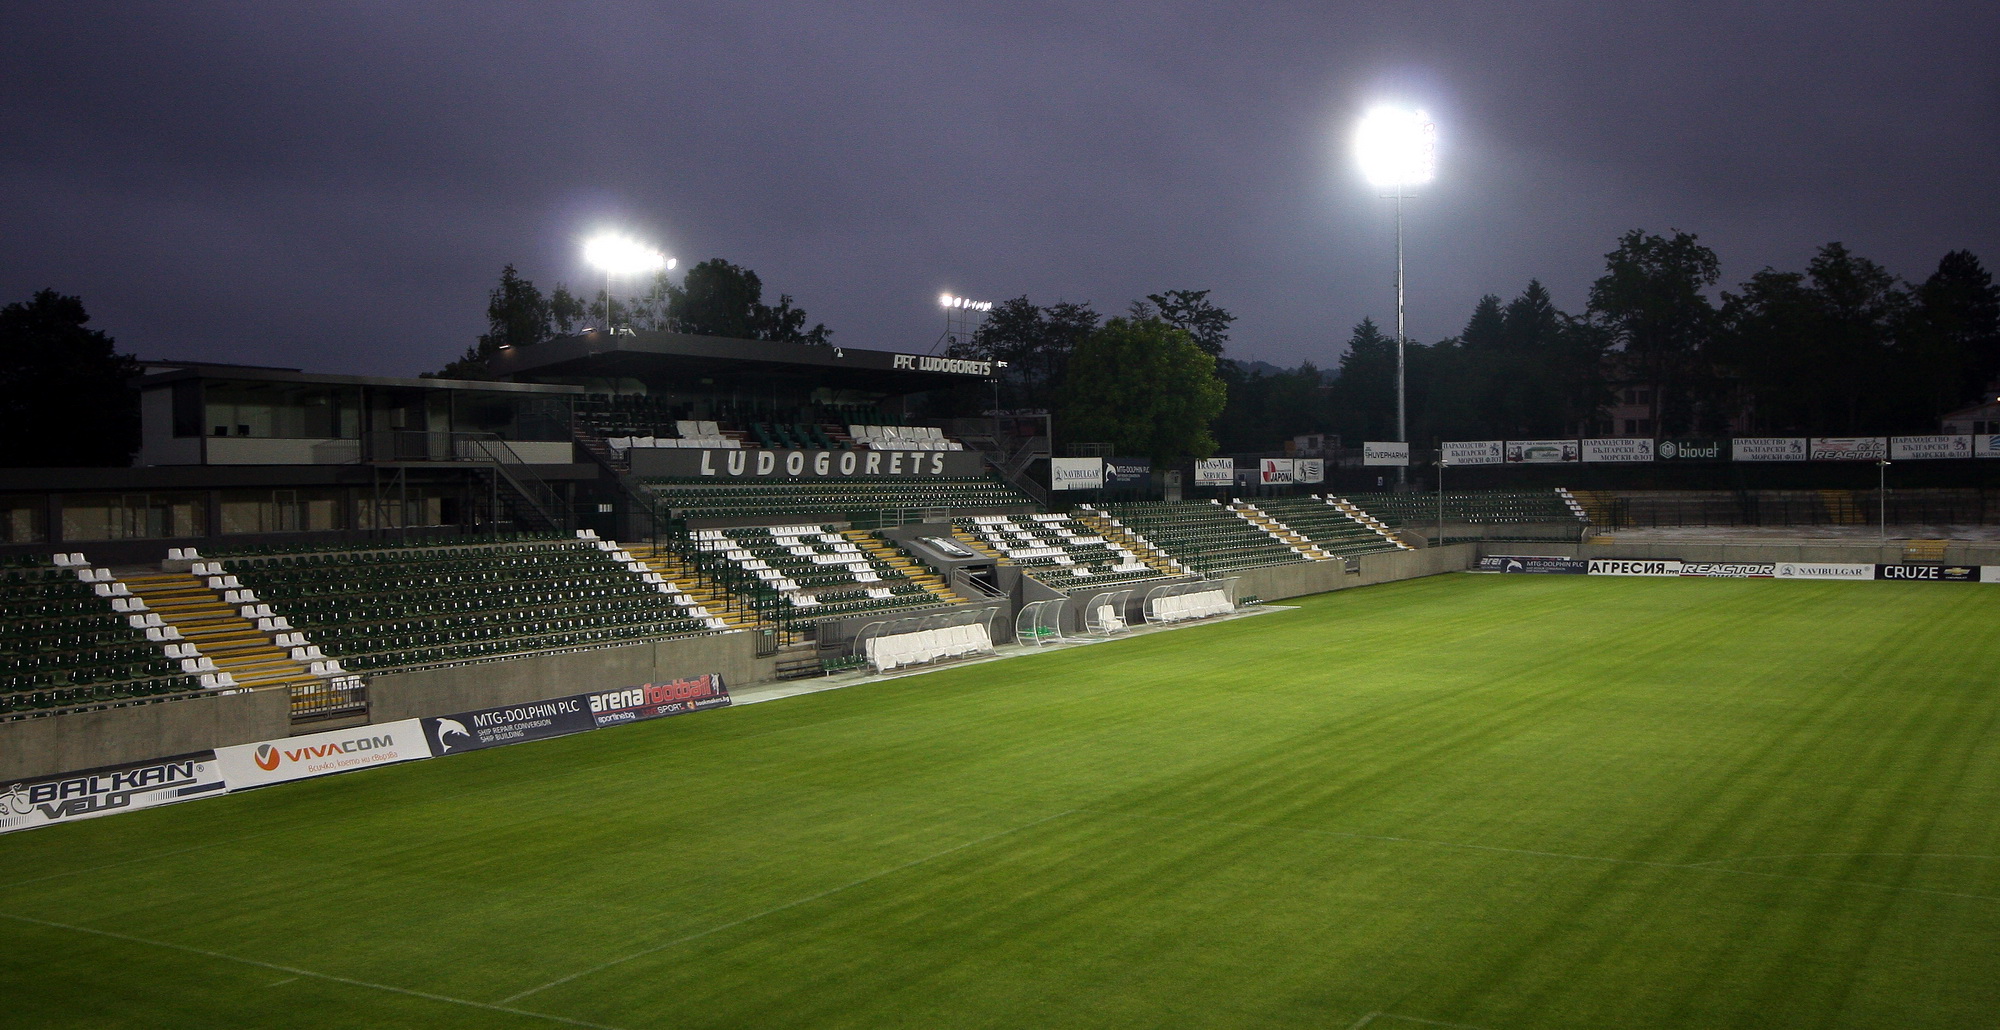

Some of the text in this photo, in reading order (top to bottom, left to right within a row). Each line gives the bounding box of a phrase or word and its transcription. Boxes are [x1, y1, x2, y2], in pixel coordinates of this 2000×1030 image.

[893, 354, 992, 376] PFC LUDOGORETS
[1583, 439, 1635, 447] ПАРАХОДСТВО
[1733, 438, 1786, 446] ПАРАХОДСТВО
[1892, 436, 1950, 444] ПАРАХОДСТВО
[1678, 441, 1719, 458] biovet
[1813, 450, 1886, 460] REACTOR
[700, 450, 945, 476] LUDOGORETS
[1063, 468, 1100, 479] NAVIBULGAR
[1203, 471, 1228, 479] SERVICES
[1526, 560, 1571, 568] MTG-DOLPHIN
[1589, 561, 1665, 574] АГРЕСИЯ
[1681, 563, 1775, 575] REACTOR
[1799, 568, 1862, 576] NAVIBULGAR
[1884, 565, 1938, 579] CRUZE
[473, 699, 580, 727] MTG-DOLPHIN PLC
[477, 718, 551, 737] SHIP REPAIR CONVERSION
[480, 729, 524, 744] SHIP BUILDING
[284, 734, 394, 762] VIVACOM
[29, 760, 196, 805] BALKAN
[37, 793, 130, 819] VELO
